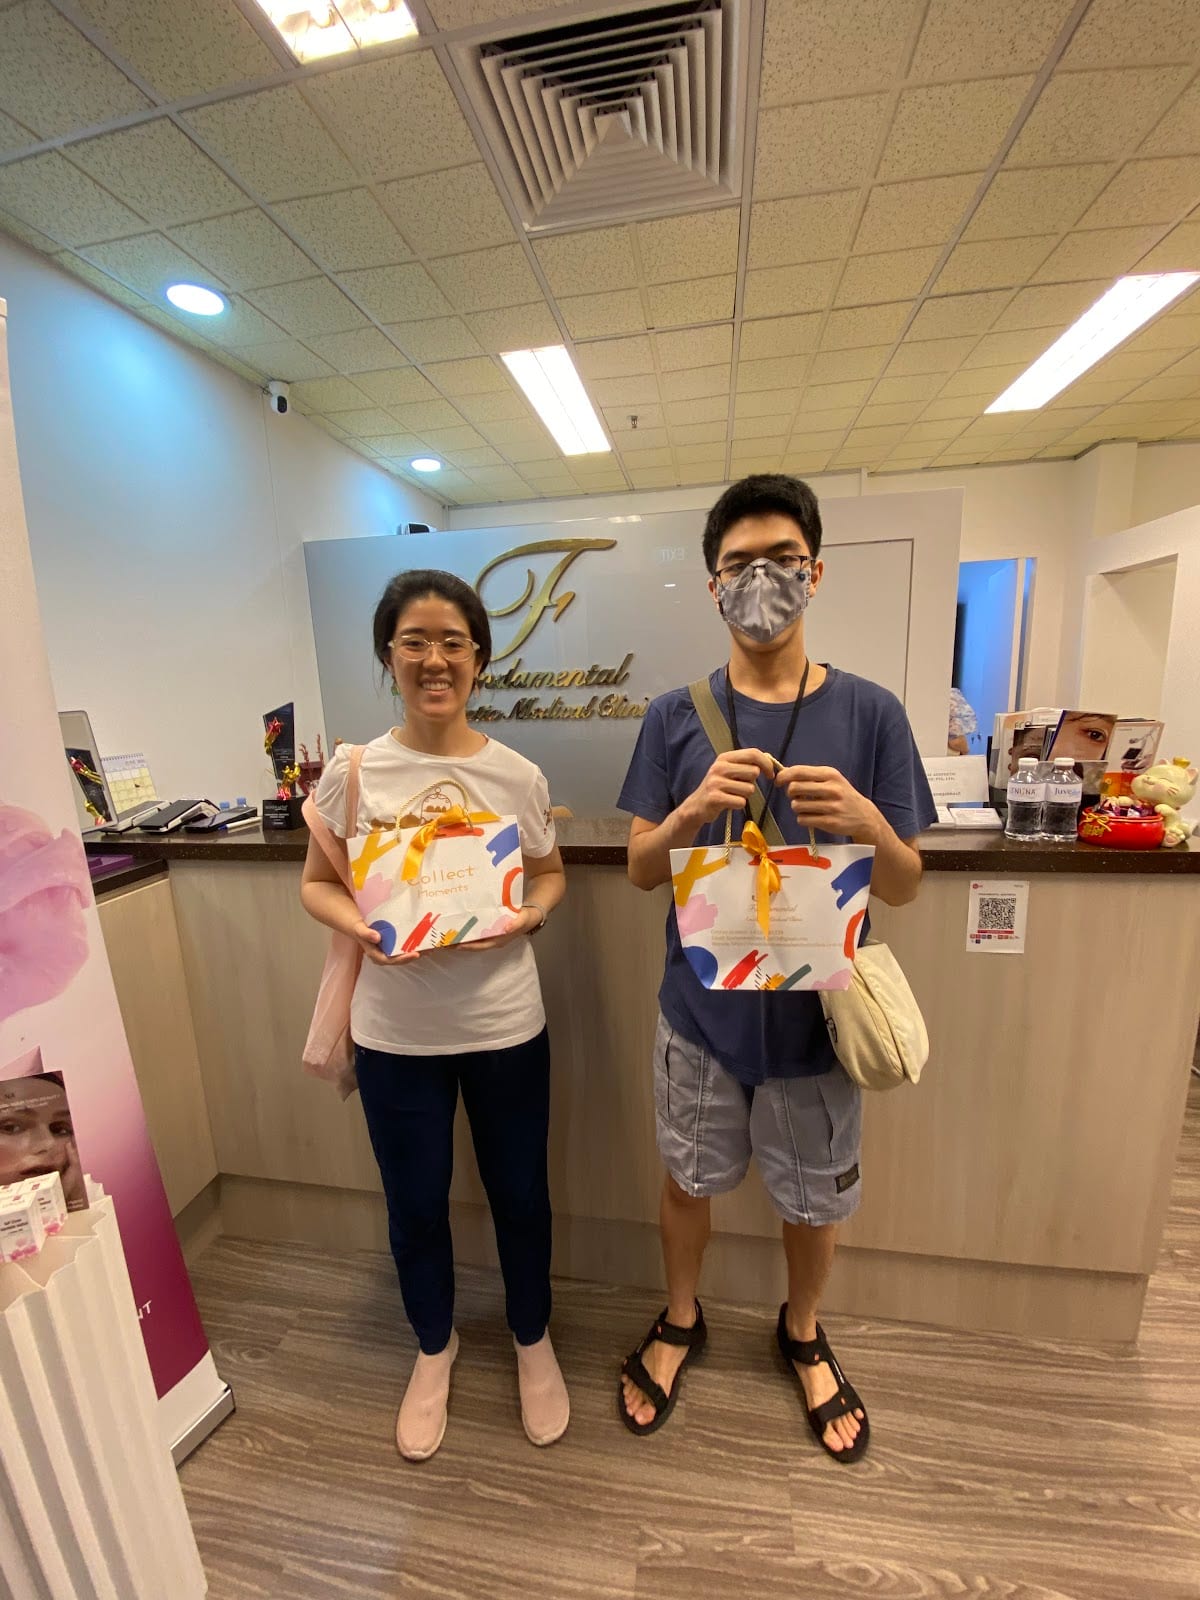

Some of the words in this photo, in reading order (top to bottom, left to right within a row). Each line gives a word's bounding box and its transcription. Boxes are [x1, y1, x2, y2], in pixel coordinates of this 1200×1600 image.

[478, 652, 634, 690] ndamental
[505, 695, 599, 721] Medical
[598, 693, 649, 719] Clini
[417, 884, 469, 898] Moments
